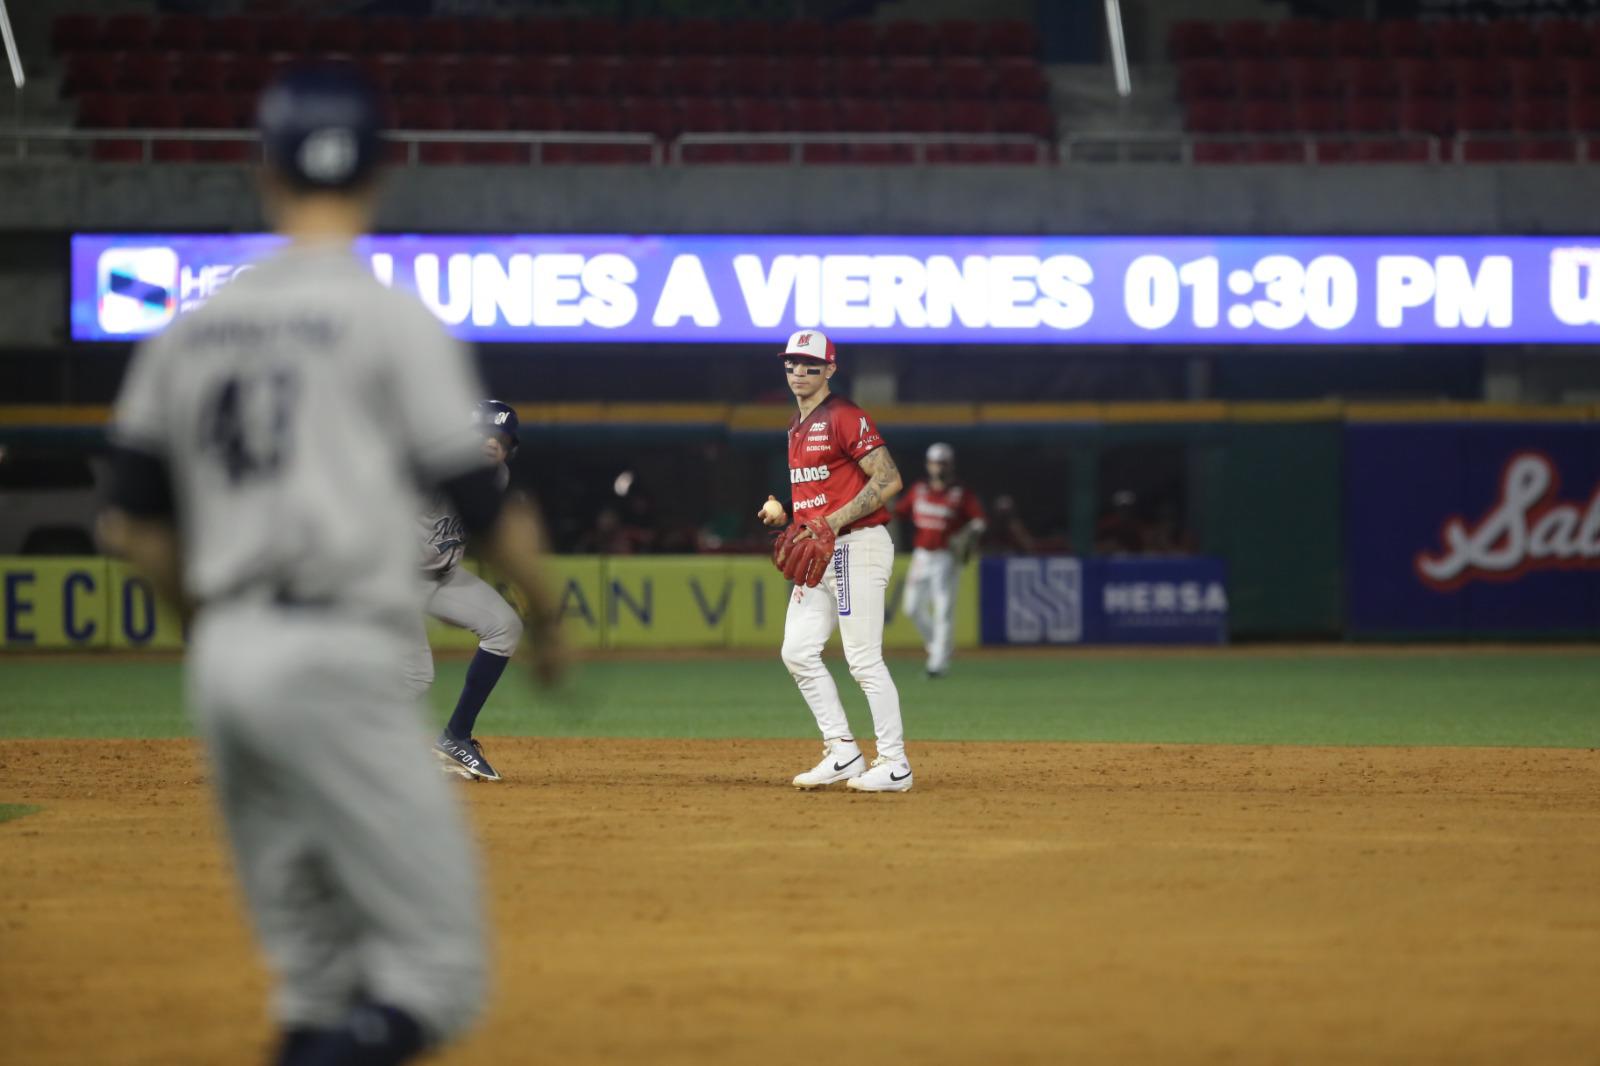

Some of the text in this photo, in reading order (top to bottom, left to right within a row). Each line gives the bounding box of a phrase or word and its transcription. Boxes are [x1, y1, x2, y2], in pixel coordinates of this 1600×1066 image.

[652, 254, 721, 327] A
[733, 254, 1095, 329] VIERNES
[1124, 254, 1358, 329] 01:30
[1376, 255, 1513, 328] PM
[1103, 582, 1227, 613] HERSA
[442, 739, 480, 770] VAPOR
